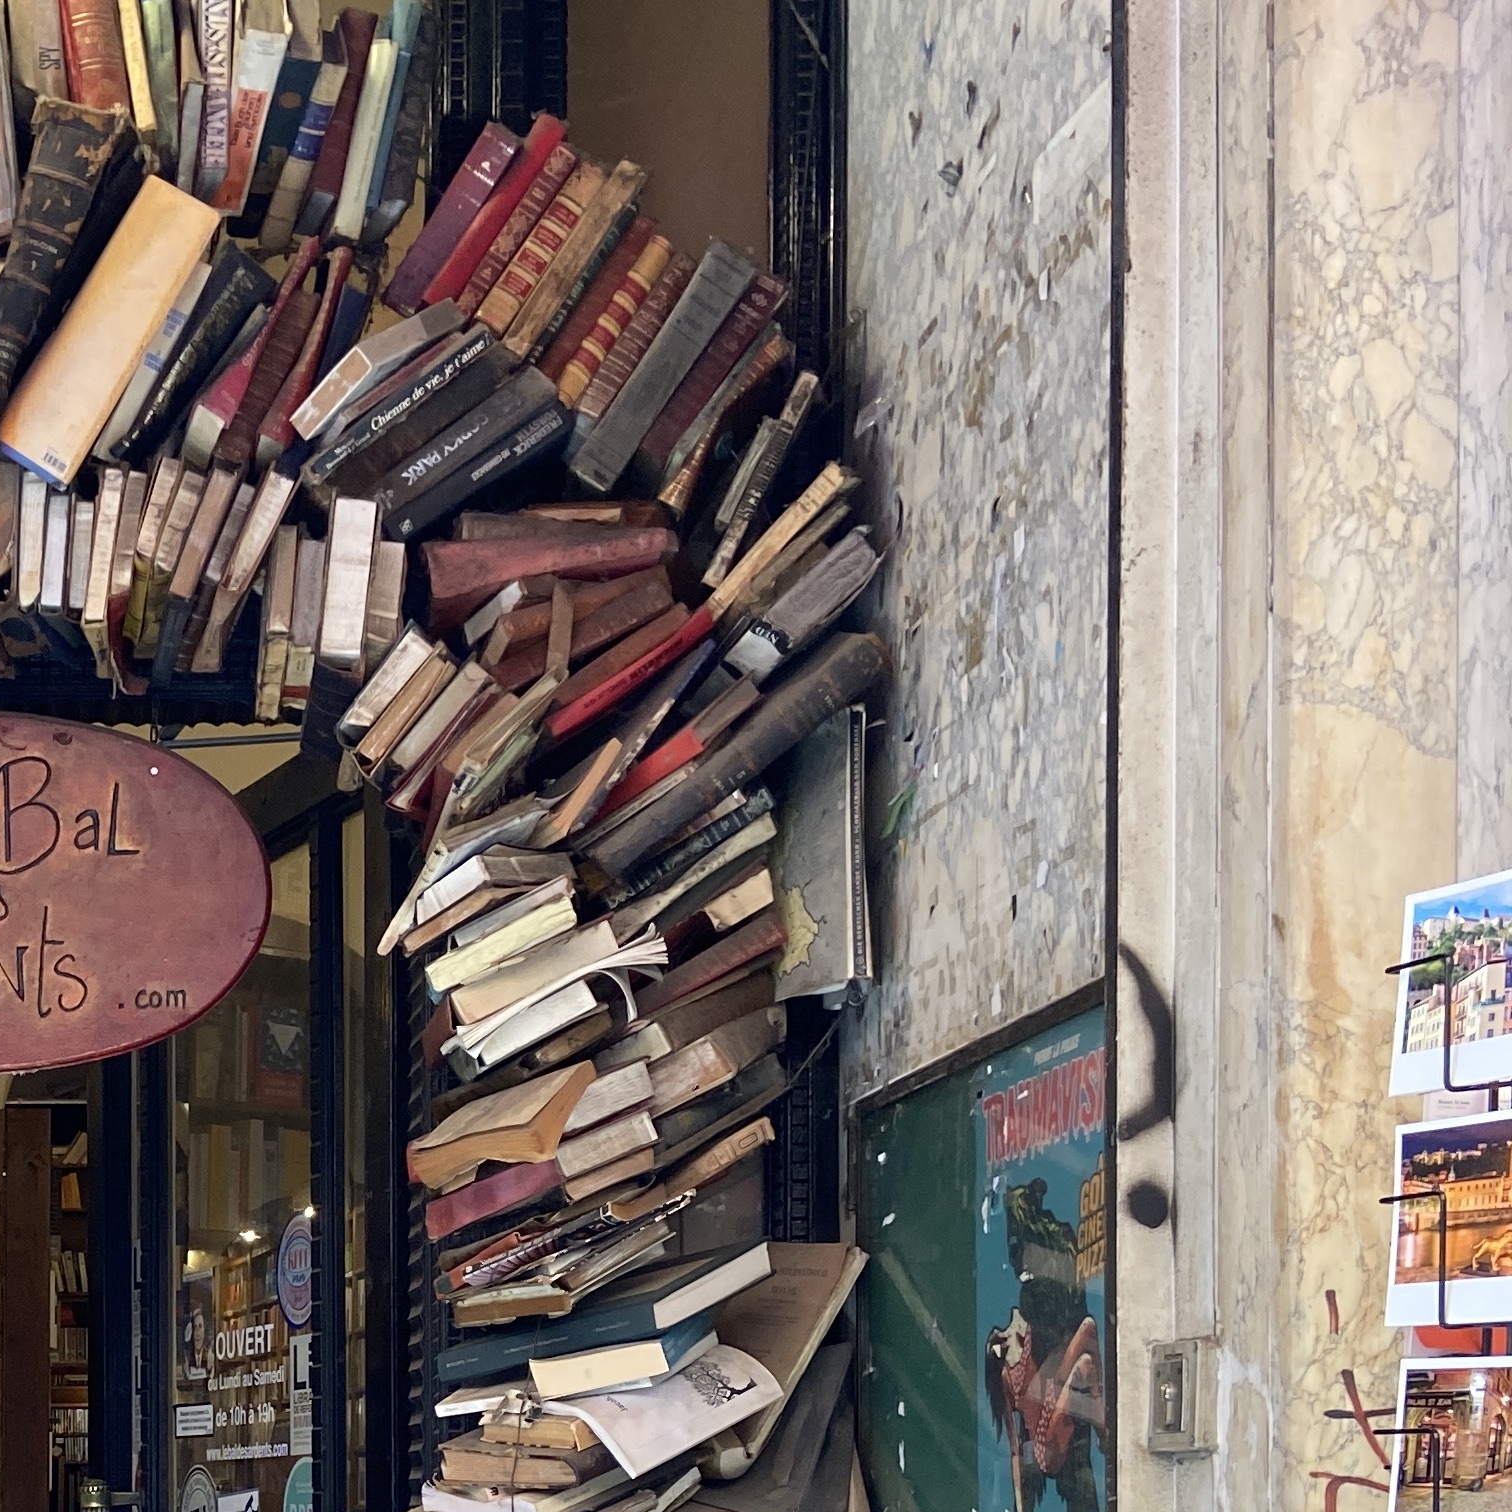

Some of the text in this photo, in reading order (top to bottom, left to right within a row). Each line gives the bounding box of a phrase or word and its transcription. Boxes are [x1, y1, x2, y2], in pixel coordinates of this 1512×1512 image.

[39, 47, 61, 71] SPY
[370, 339, 486, 431] Chienne de vie, je t'aime
[512, 414, 564, 457] FREDERICK
[400, 449, 443, 486] PARK
[117, 984, 187, 1010] .com
[216, 1323, 274, 1360] OUVERT
[219, 1370, 241, 1390] Lundi
[242, 1373, 252, 1387] au
[253, 1364, 285, 1386] Samedi
[216, 1407, 227, 1427] de
[230, 1402, 246, 1426] 10h
[248, 1403, 255, 1423] à
[257, 1402, 275, 1423] 19h
